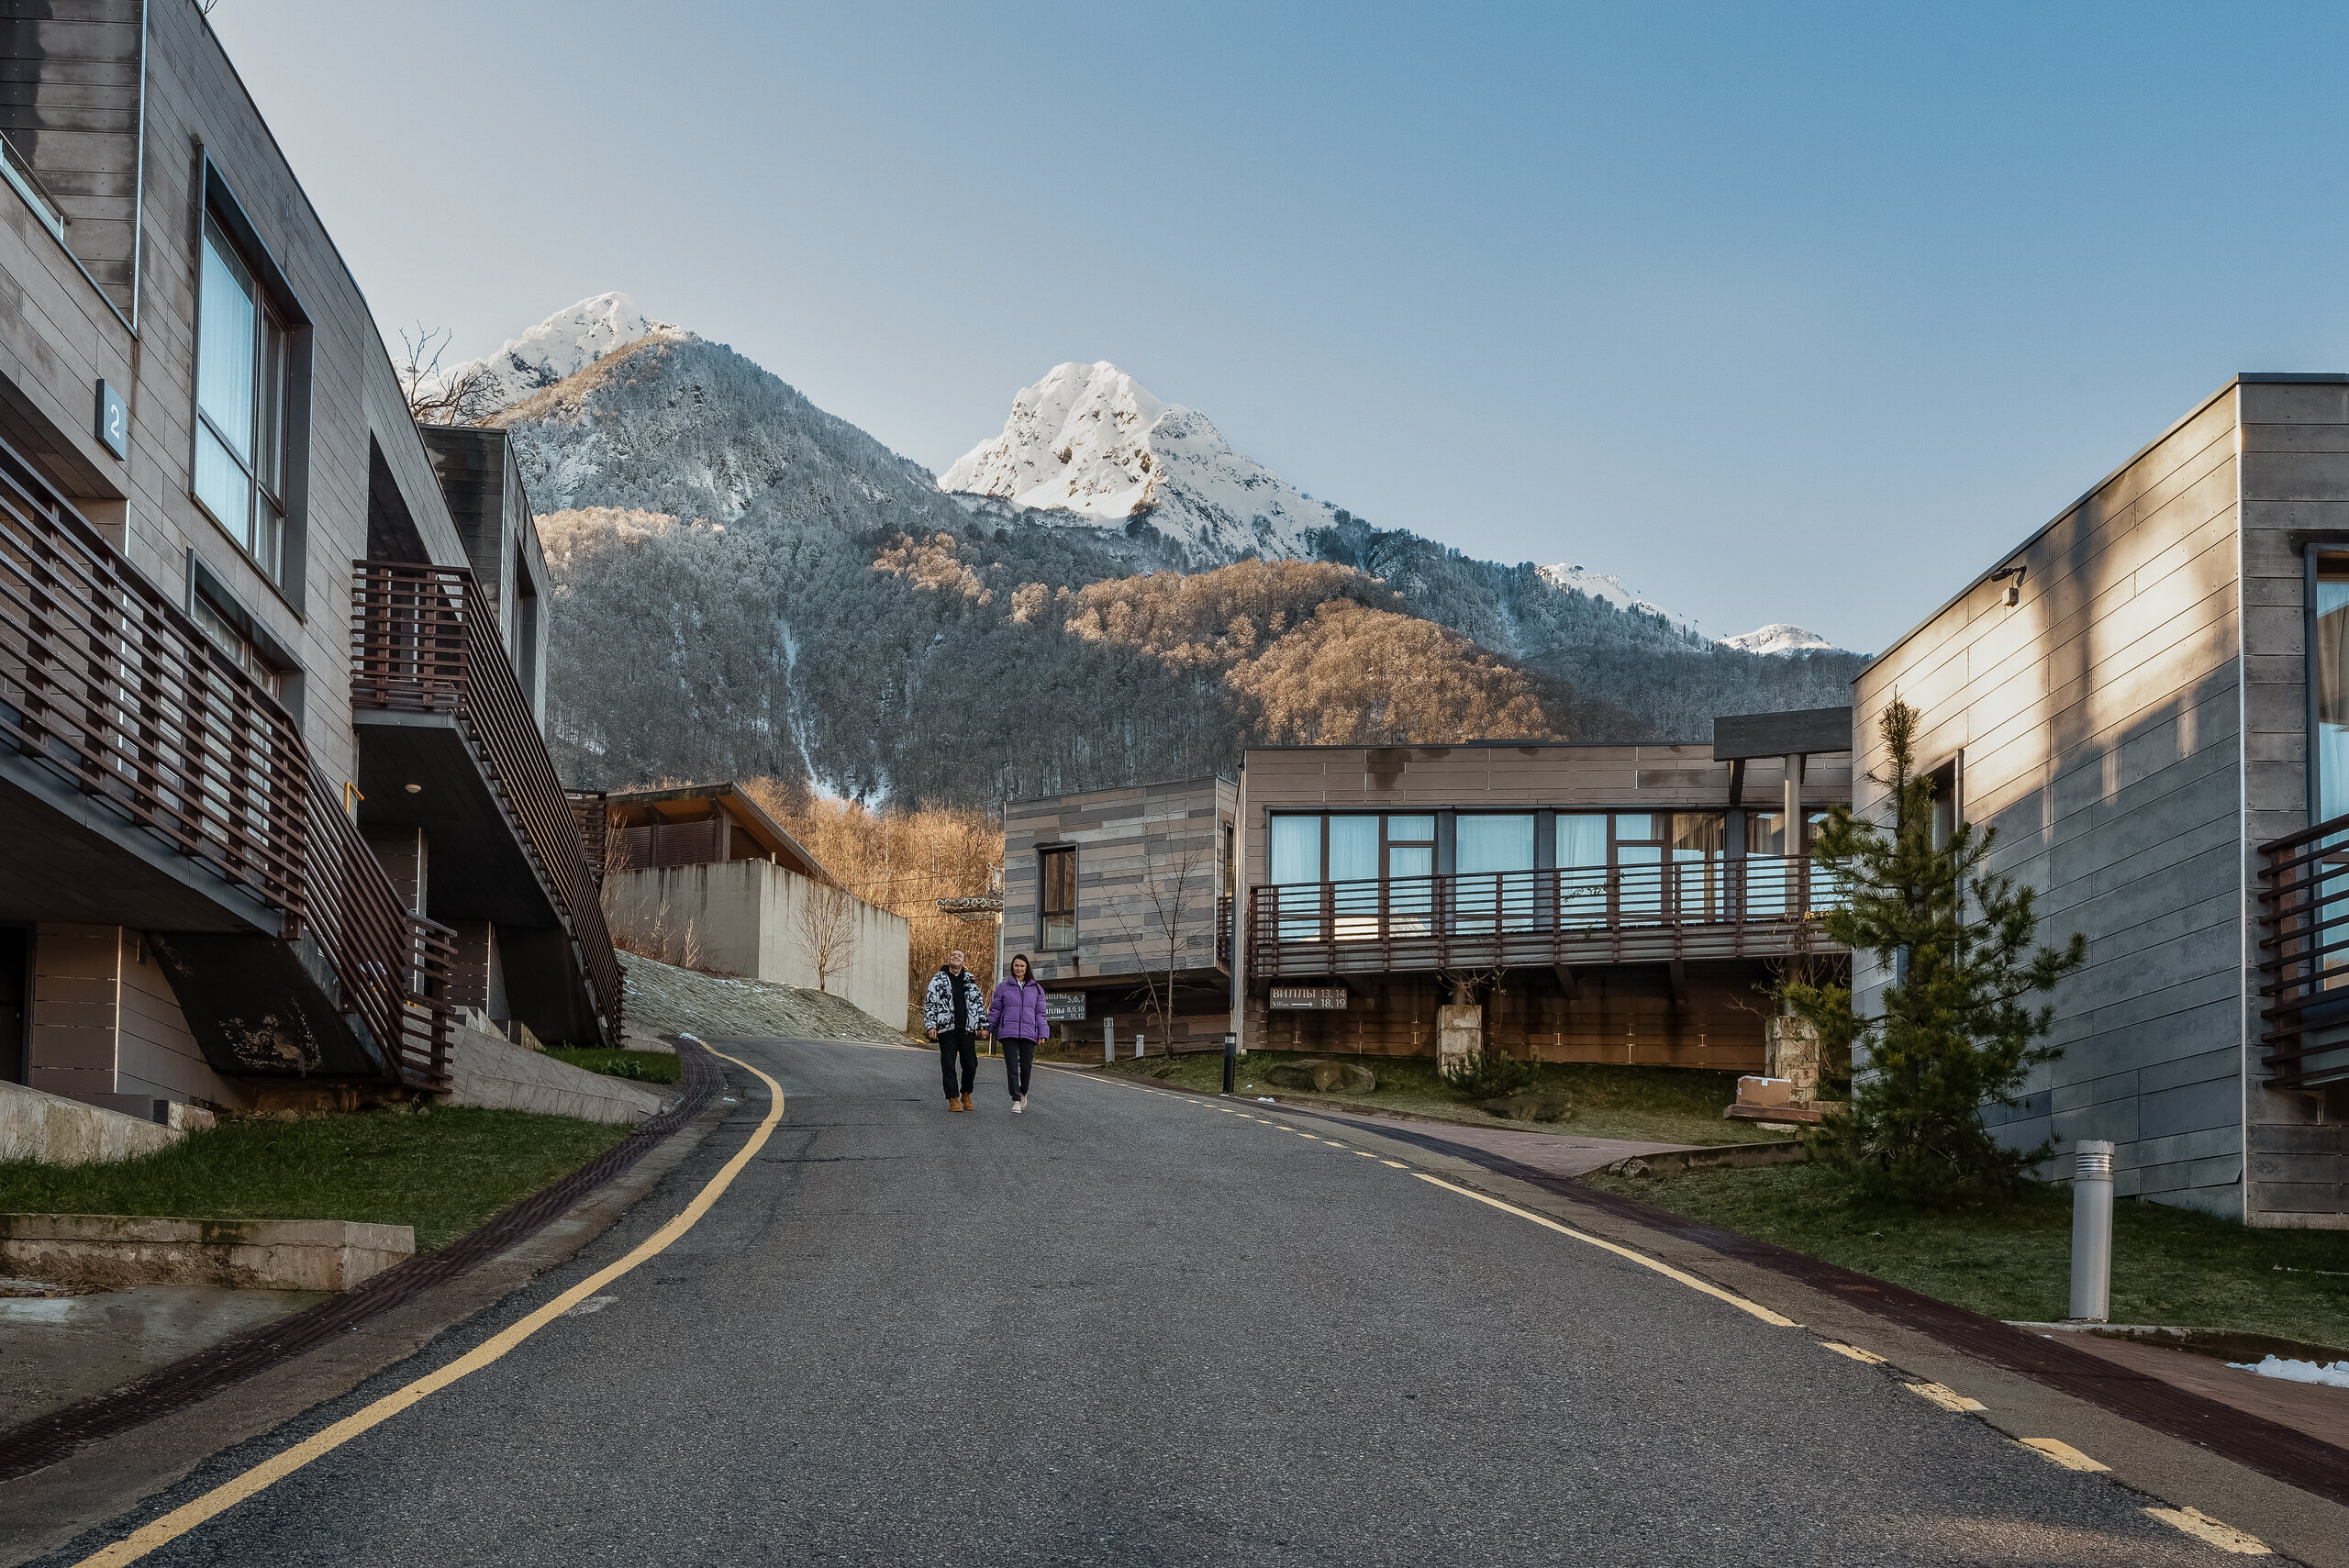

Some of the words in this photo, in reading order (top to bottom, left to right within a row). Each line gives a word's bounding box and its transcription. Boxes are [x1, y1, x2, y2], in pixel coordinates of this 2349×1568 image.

[110, 404, 120, 440] 2
[1273, 989, 1316, 998] ВИЛЛЫ
[1336, 989, 1346, 998] 14
[1336, 998, 1346, 1007] 19
